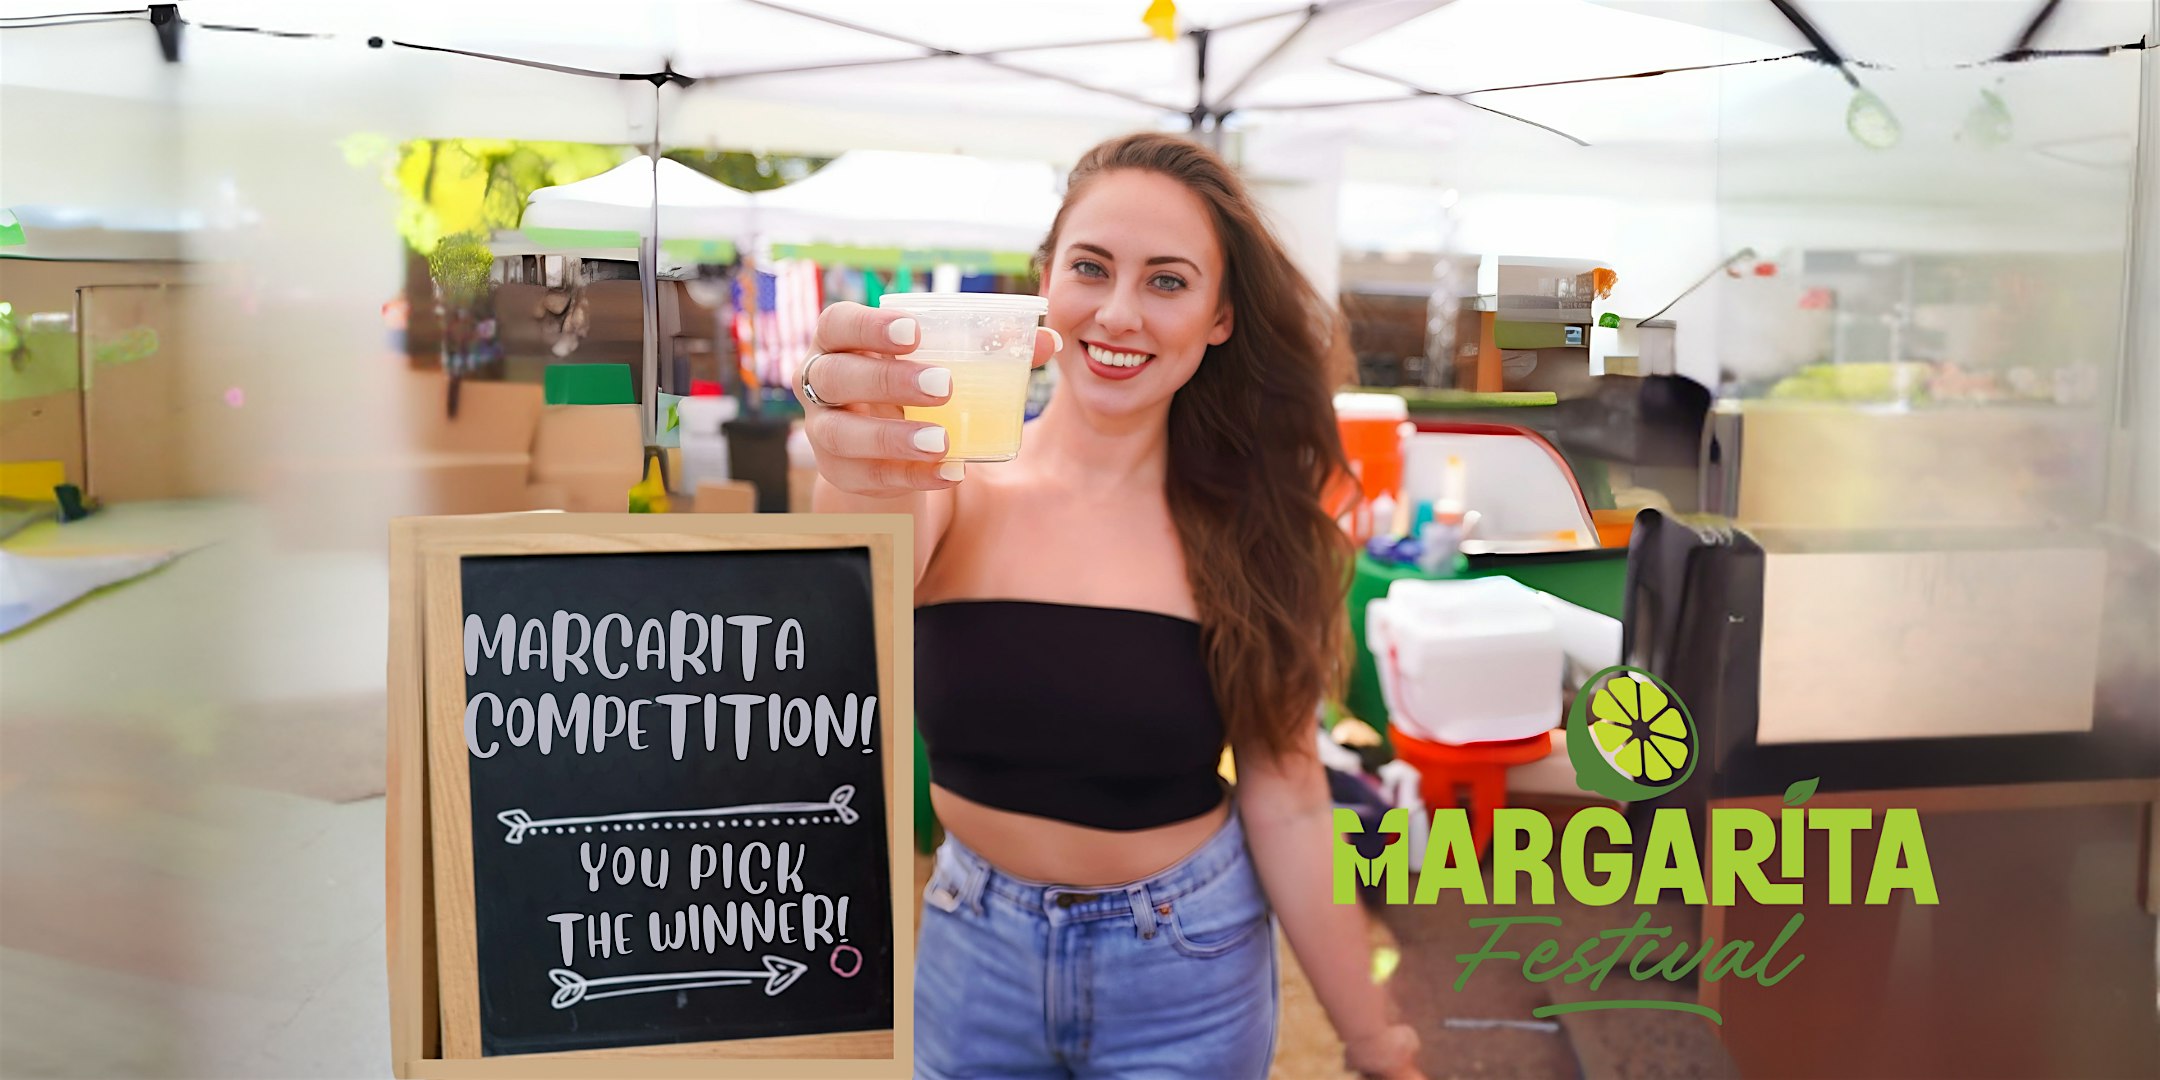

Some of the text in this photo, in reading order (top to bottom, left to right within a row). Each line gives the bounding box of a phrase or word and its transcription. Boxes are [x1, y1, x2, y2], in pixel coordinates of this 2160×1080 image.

[463, 692, 878, 761] COMPETITION!
[580, 841, 806, 895] YOU PICK
[546, 892, 850, 967] THE WINNER!
